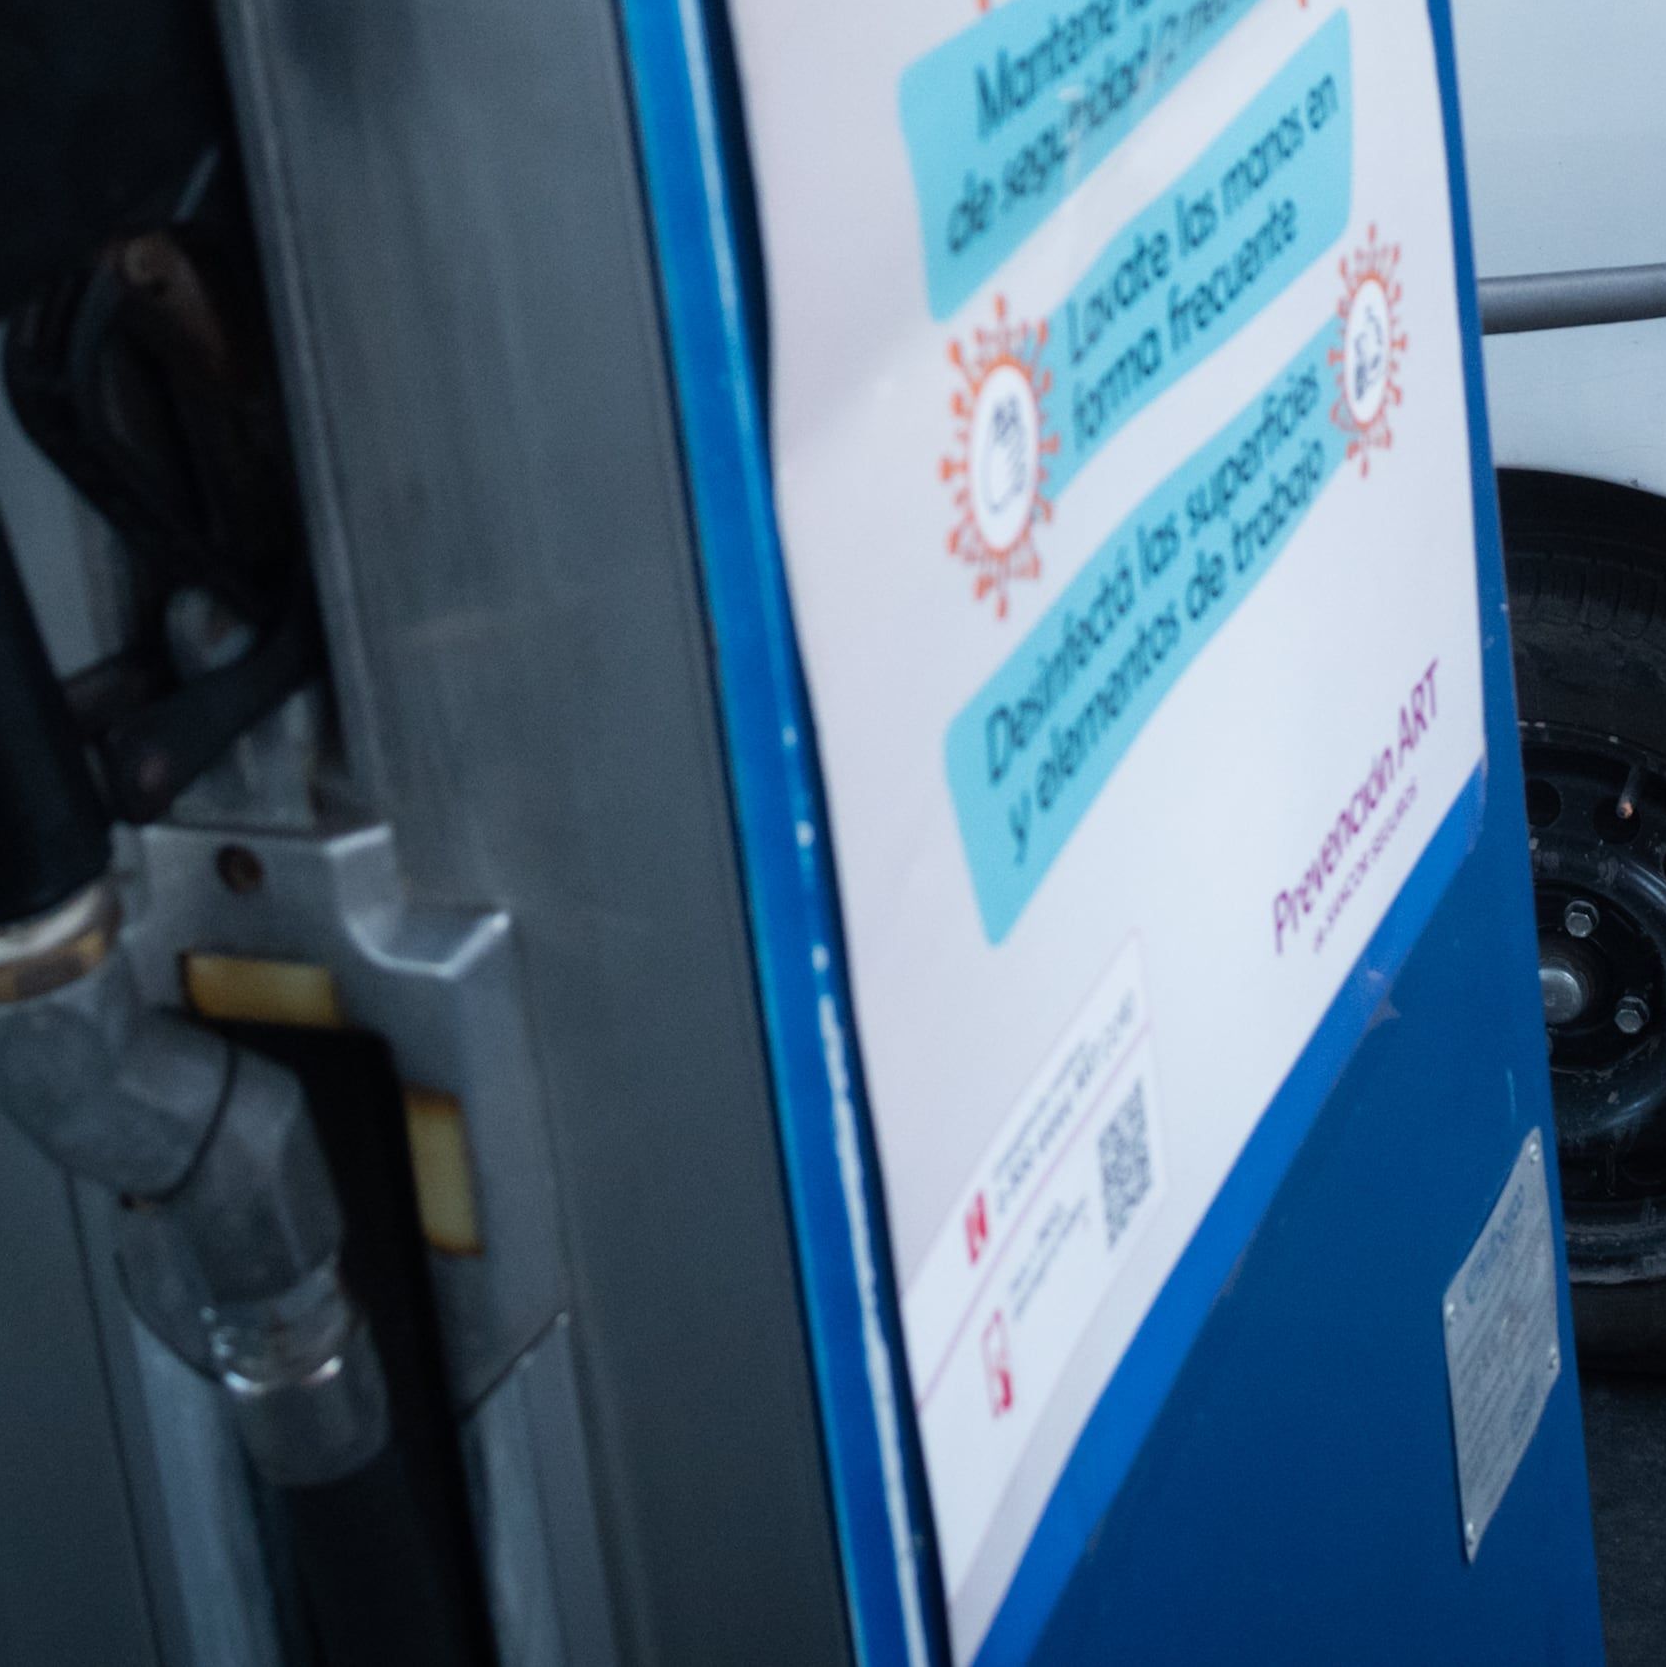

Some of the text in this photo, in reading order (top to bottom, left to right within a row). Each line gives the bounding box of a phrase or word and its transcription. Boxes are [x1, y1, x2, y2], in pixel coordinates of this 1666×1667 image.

[947, 169, 996, 257] de
[1174, 189, 1219, 260] las
[1220, 102, 1306, 216] manos
[1305, 71, 1339, 134] en
[1072, 197, 1298, 455] forma frecuente
[1136, 511, 1182, 587] las
[1184, 365, 1321, 541] superficies
[1008, 439, 1325, 869] y elementos de trabajo
[1397, 658, 1438, 770] ART
